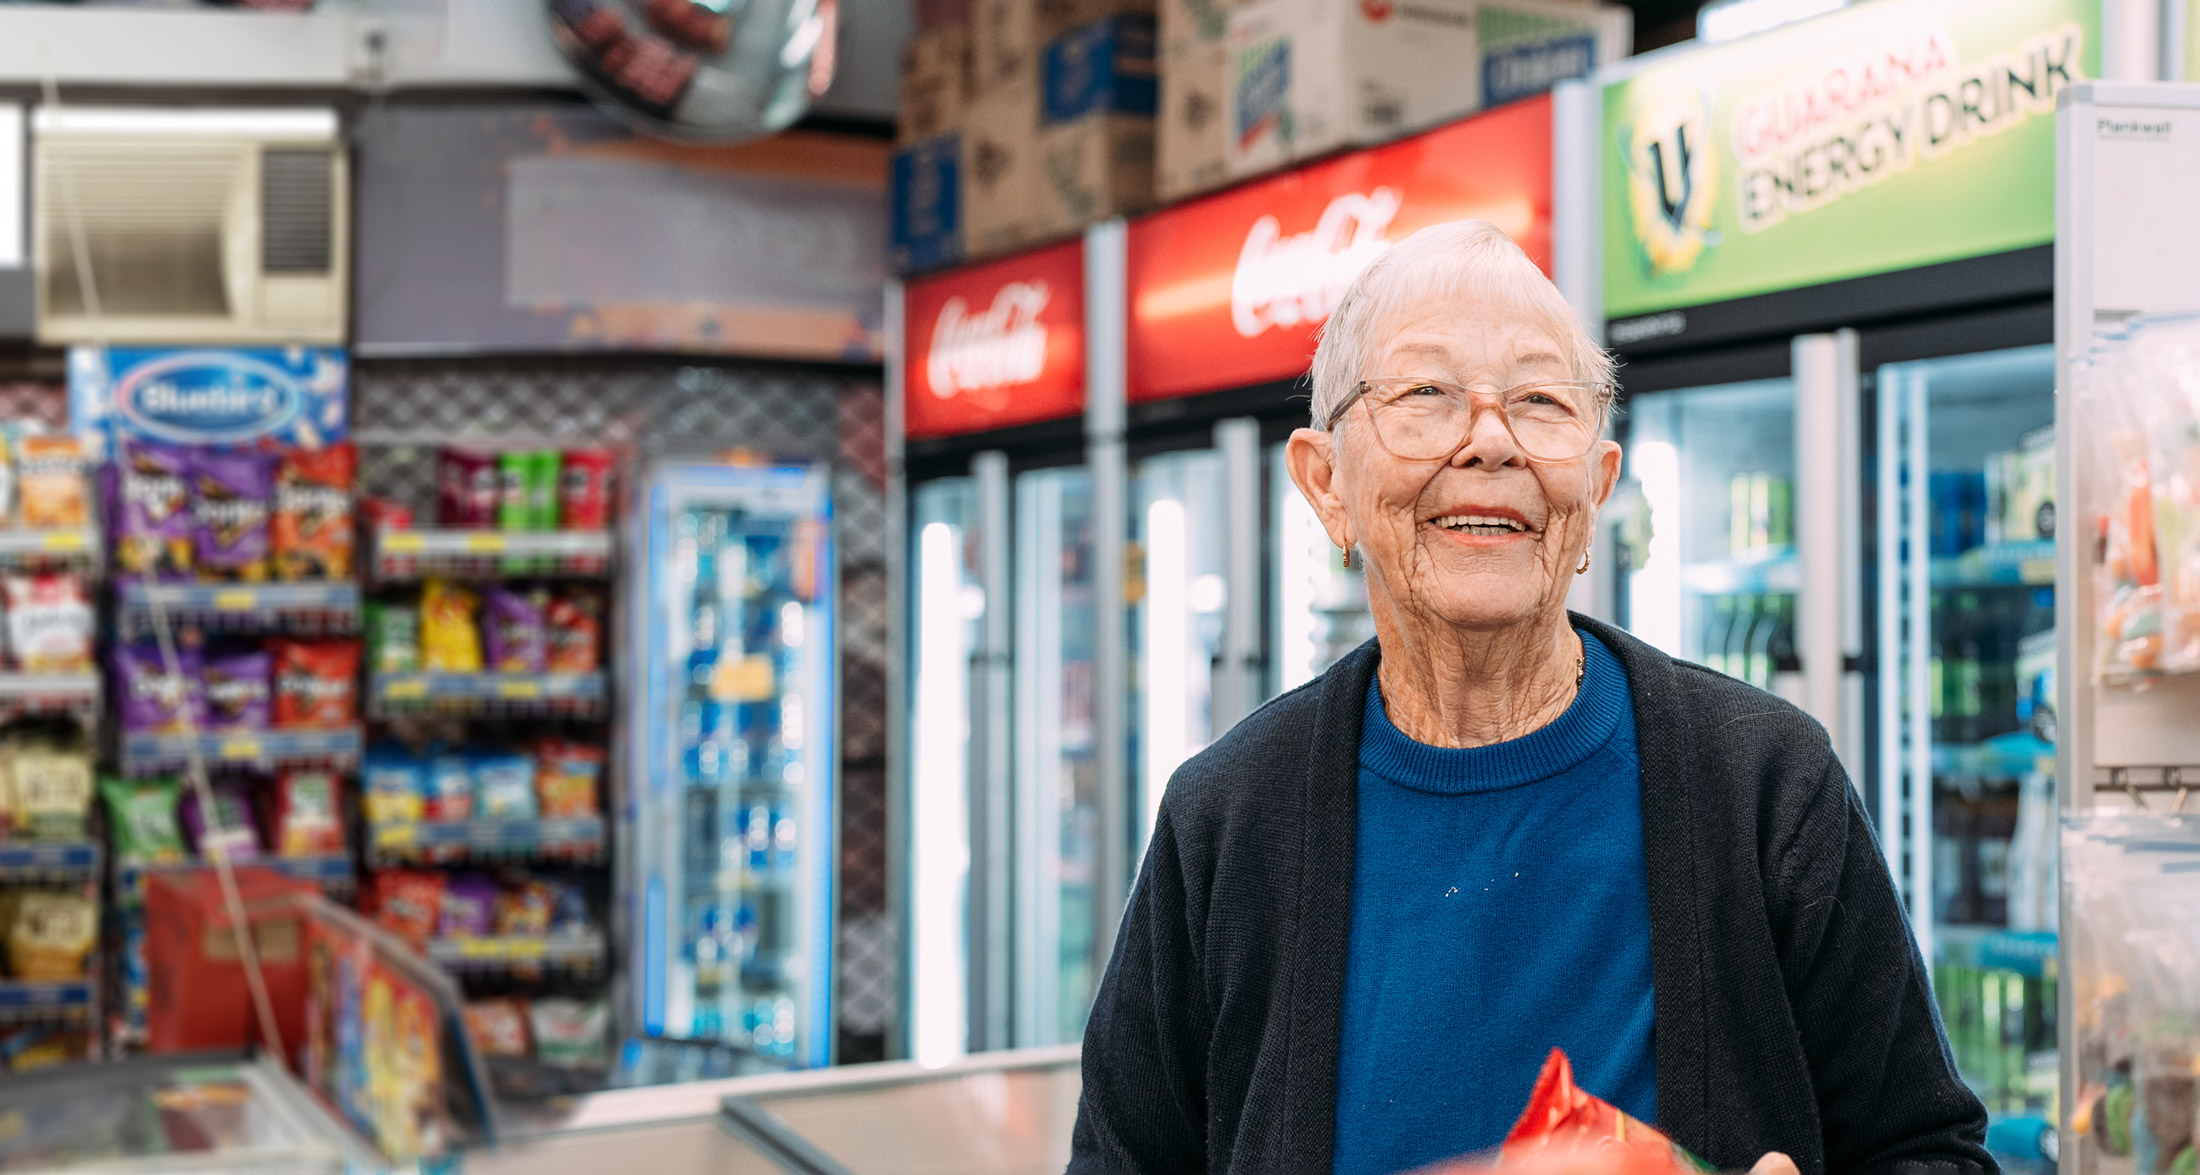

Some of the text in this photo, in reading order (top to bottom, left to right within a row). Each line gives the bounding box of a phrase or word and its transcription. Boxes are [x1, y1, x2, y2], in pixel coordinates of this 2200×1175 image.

[1736, 33, 1947, 158] GUARANA
[1743, 34, 2072, 222] ENERGY DRINK
[141, 374, 279, 415] Bluebird
